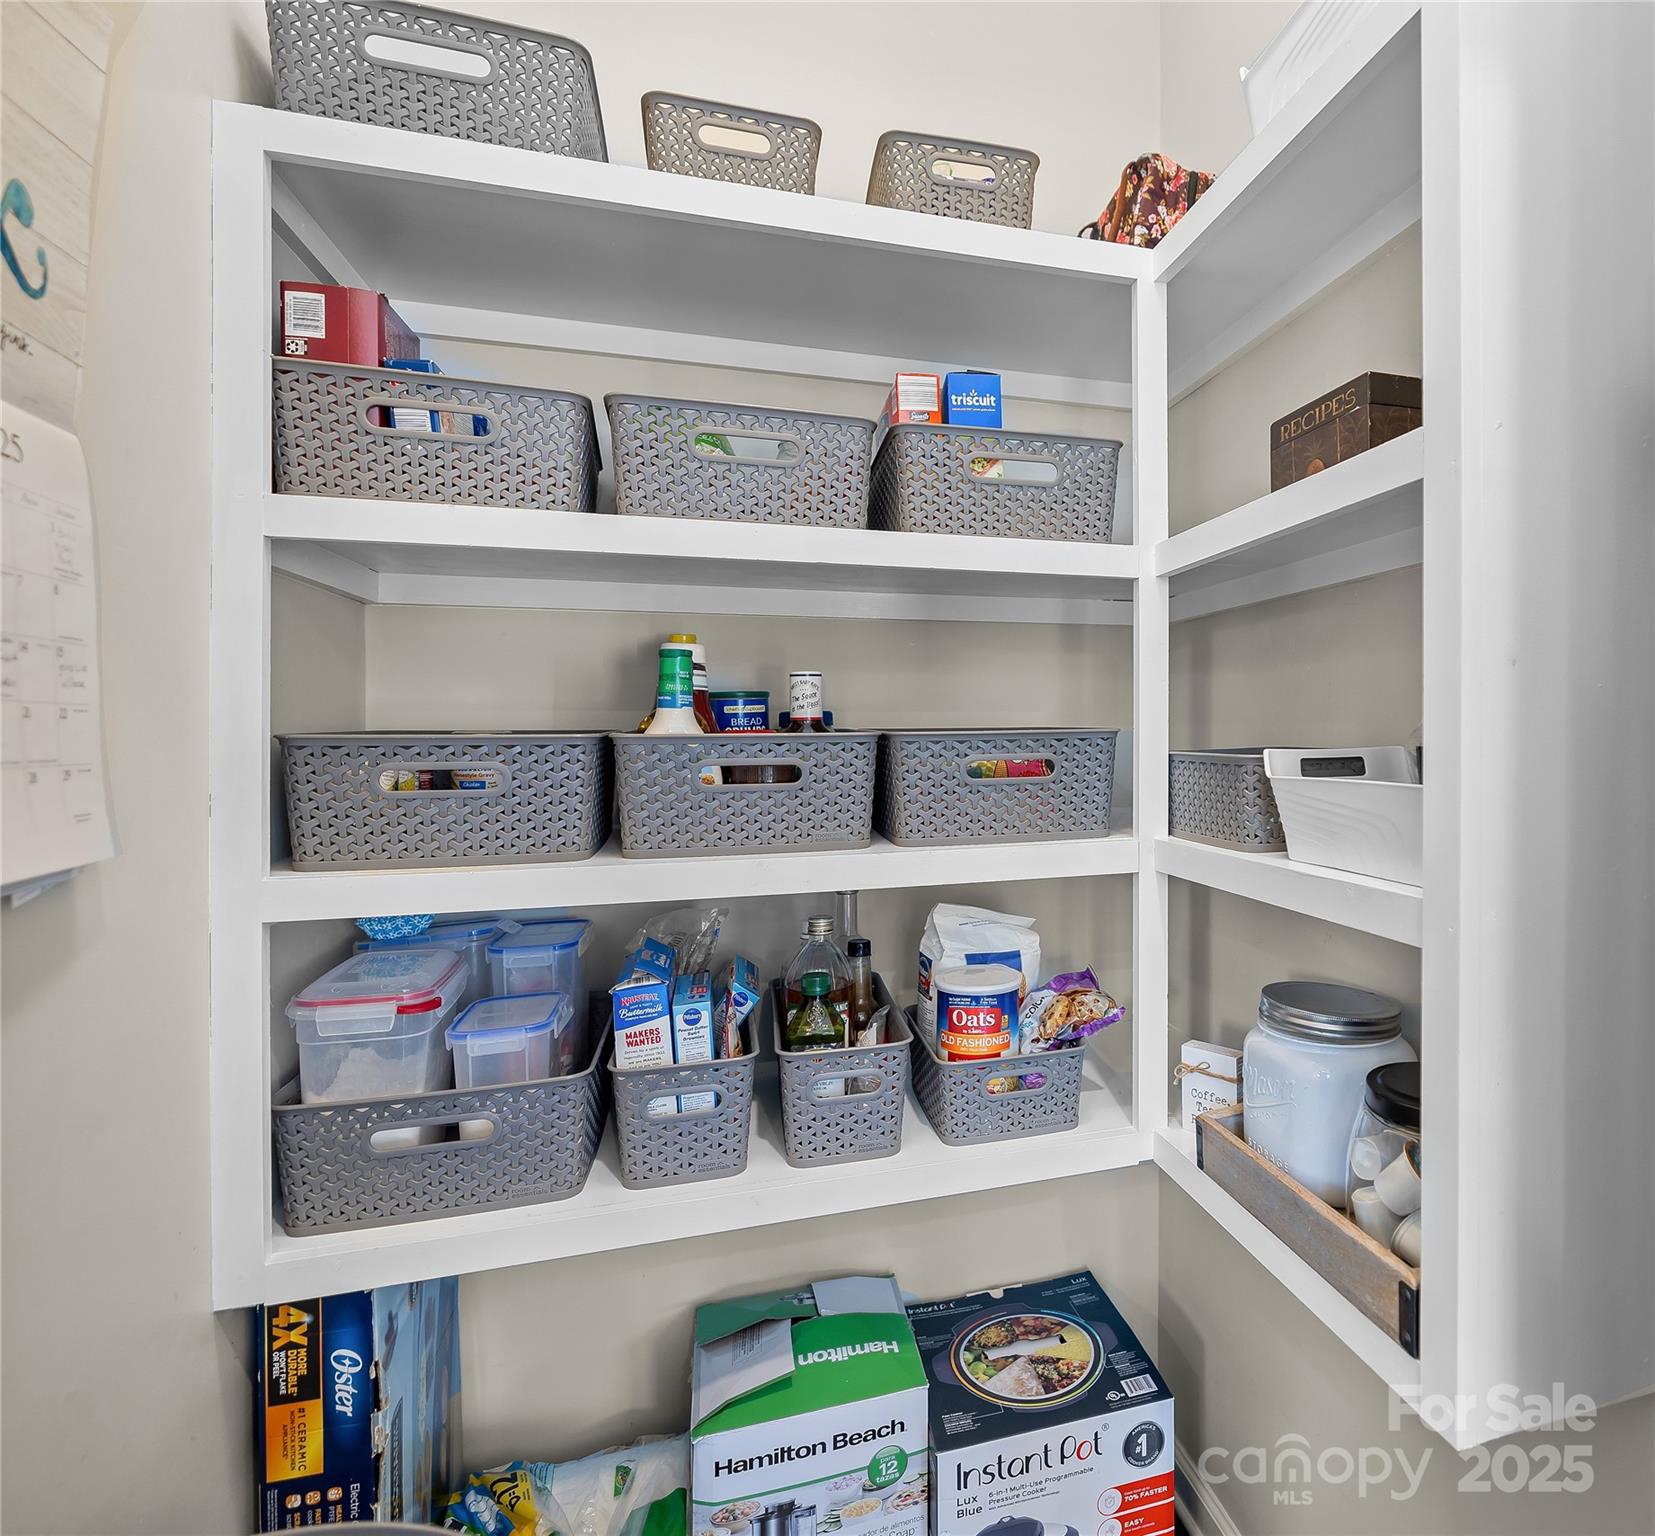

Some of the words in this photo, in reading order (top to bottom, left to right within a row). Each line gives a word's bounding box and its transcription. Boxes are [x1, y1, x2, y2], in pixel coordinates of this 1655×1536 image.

[951, 394, 996, 407] triscuit
[1280, 387, 1357, 443] RECIPES
[731, 717, 762, 726] BREAD
[619, 1003, 663, 1018] Buttermilk
[952, 1009, 996, 1026] Oats
[625, 1027, 661, 1040] MAKERS
[626, 1035, 661, 1048] WANTED
[941, 1033, 955, 1045] OLD
[956, 1034, 1010, 1047] FASHIONED
[272, 1305, 308, 1350] 4X
[798, 1341, 900, 1366] Hamilton
[298, 1348, 308, 1376] MORE
[331, 1349, 362, 1416] Oster
[298, 1408, 306, 1418] #1
[298, 1422, 306, 1472] CERAMIC
[714, 1441, 827, 1478] Hamilton
[832, 1419, 905, 1451] Beach
[1136, 1433, 1147, 1456] #1
[880, 1455, 896, 1464] para
[956, 1442, 1053, 1492] Instant
[1060, 1430, 1102, 1465] Pot
[880, 1460, 898, 1476] 12
[876, 1473, 900, 1483] tazas
[988, 1488, 1009, 1498] 6-in-1
[1010, 1480, 1042, 1493] Multi-Use
[1044, 1466, 1094, 1484] Programmable
[350, 1483, 361, 1518] Electric
[956, 1495, 978, 1506] Lux
[988, 1494, 1020, 1505] Pressure
[1022, 1486, 1048, 1497] Cooker
[1124, 1494, 1139, 1502] 70%
[1140, 1486, 1168, 1498] FASTER
[956, 1506, 982, 1519] Blue
[890, 1515, 925, 1530] alimentos
[1124, 1518, 1144, 1528] EASY
